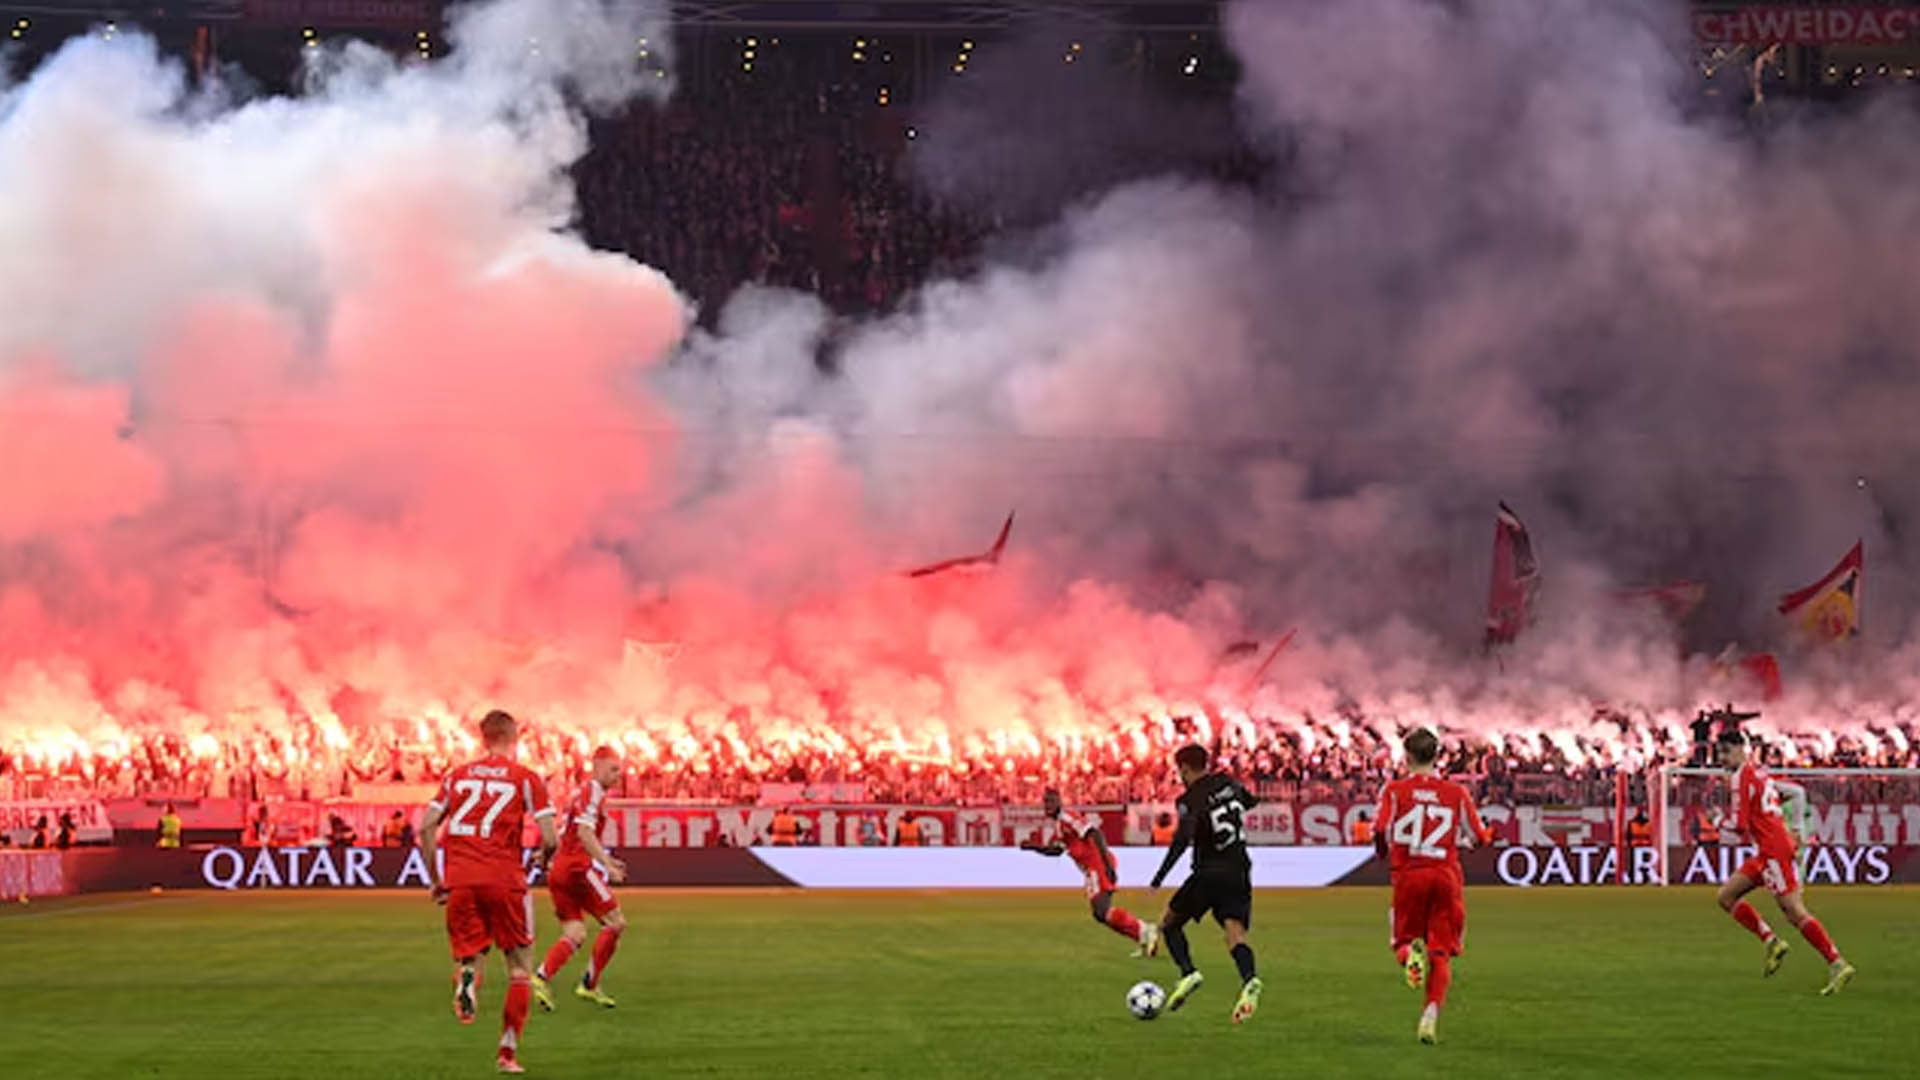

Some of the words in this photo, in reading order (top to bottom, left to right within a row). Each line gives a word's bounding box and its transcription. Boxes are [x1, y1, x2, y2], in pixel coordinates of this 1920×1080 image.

[1694, 9, 1920, 40] CHWEIDAC
[449, 779, 516, 838] 27
[1393, 803, 1453, 859] 42
[202, 846, 375, 888] QATAR
[1497, 846, 1662, 887] QATAR
[1683, 846, 1891, 885] AIAYS
